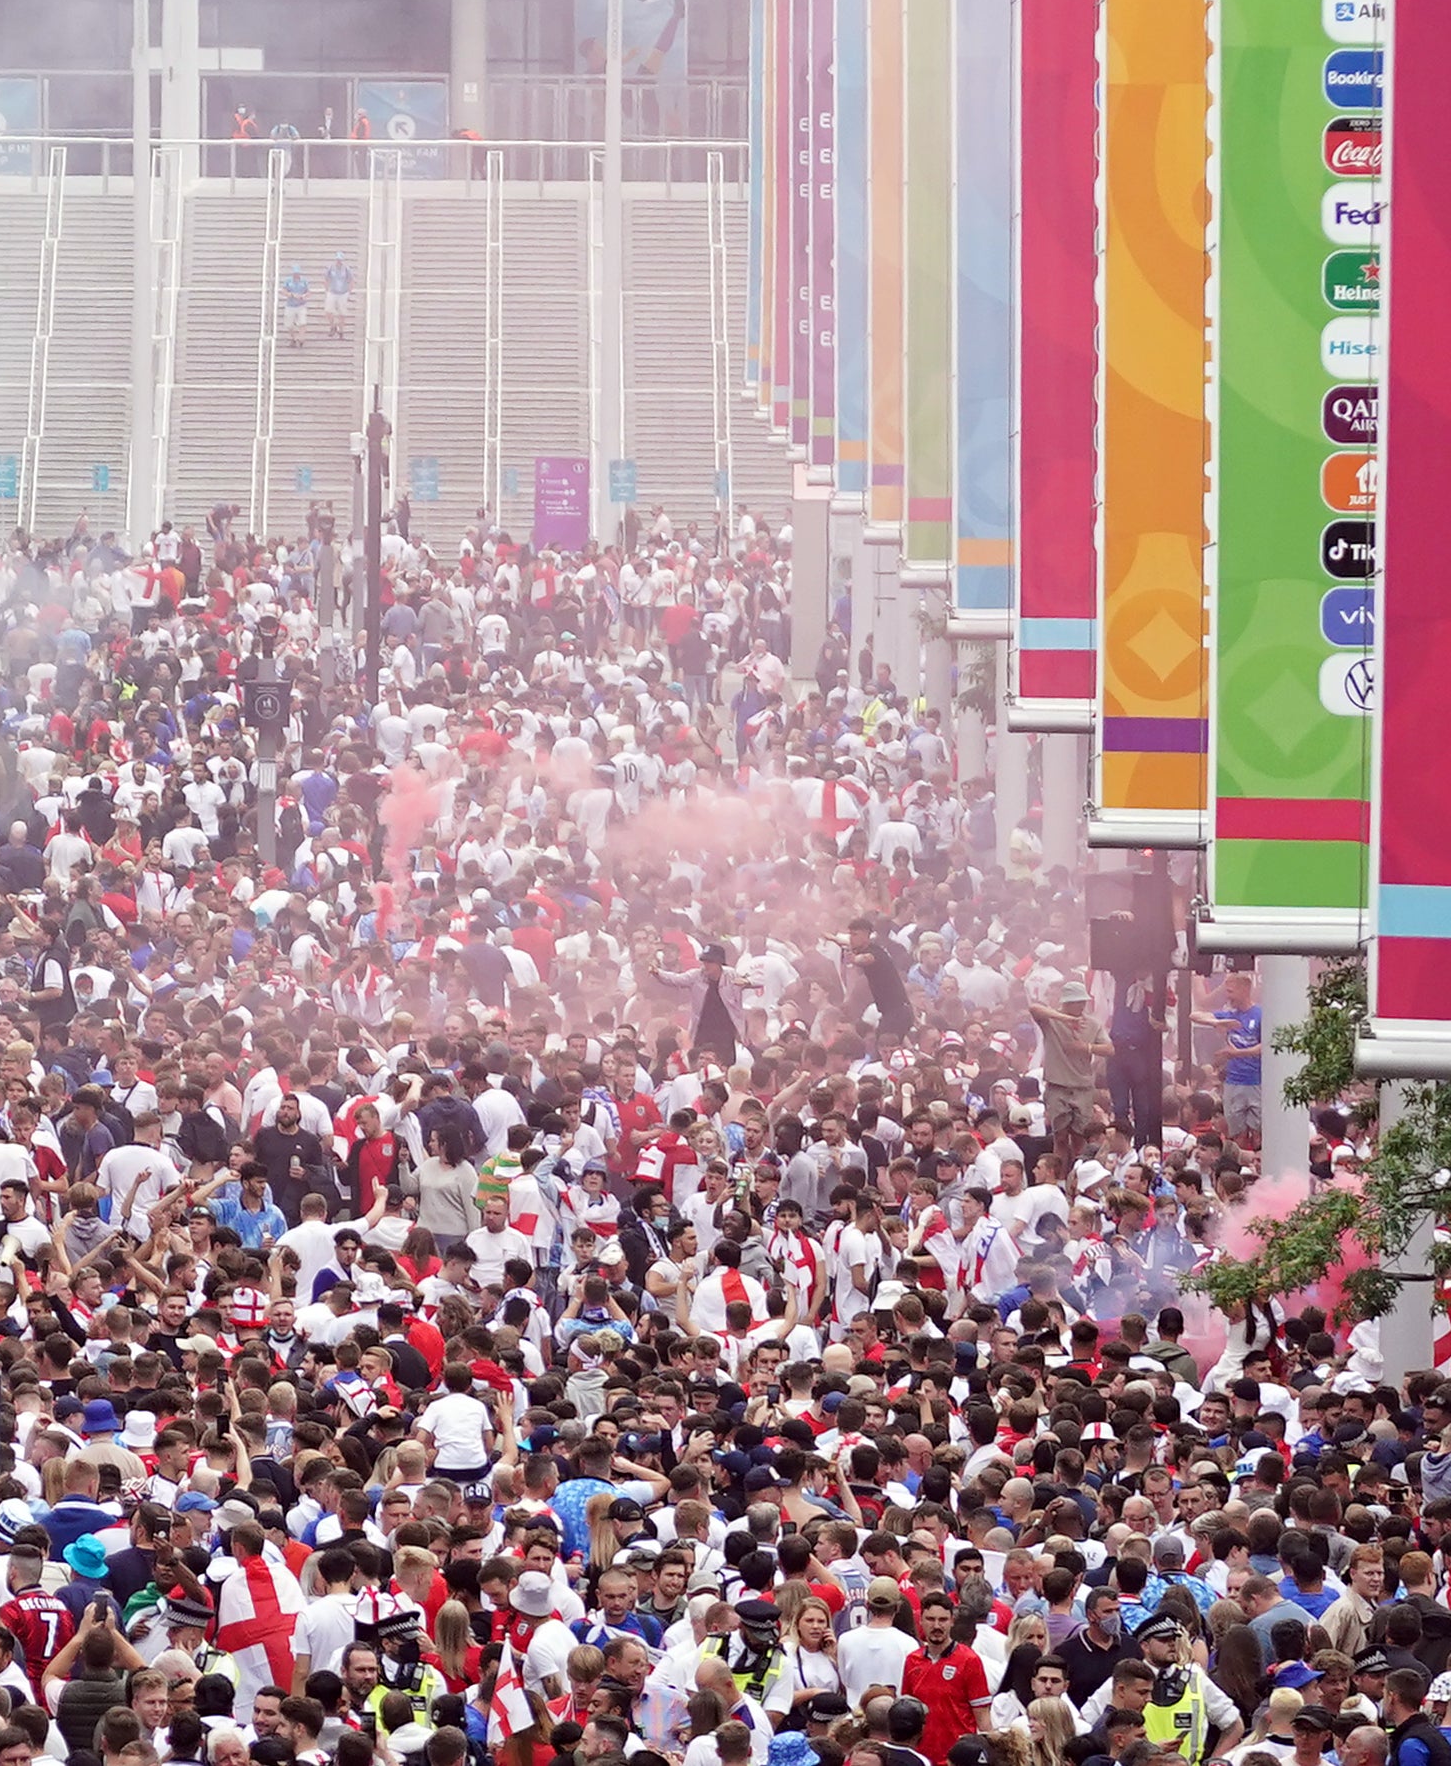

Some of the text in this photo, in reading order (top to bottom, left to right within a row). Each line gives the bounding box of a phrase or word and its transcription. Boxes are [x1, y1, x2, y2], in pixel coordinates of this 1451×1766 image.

[1335, 201, 1380, 226] Fed
[1333, 284, 1381, 301] Heine
[1329, 340, 1379, 356] Hise
[1332, 398, 1378, 421] QAT
[1348, 495, 1374, 506] JUST
[624, 763, 638, 782] 10
[39, 1611, 59, 1658] 7
